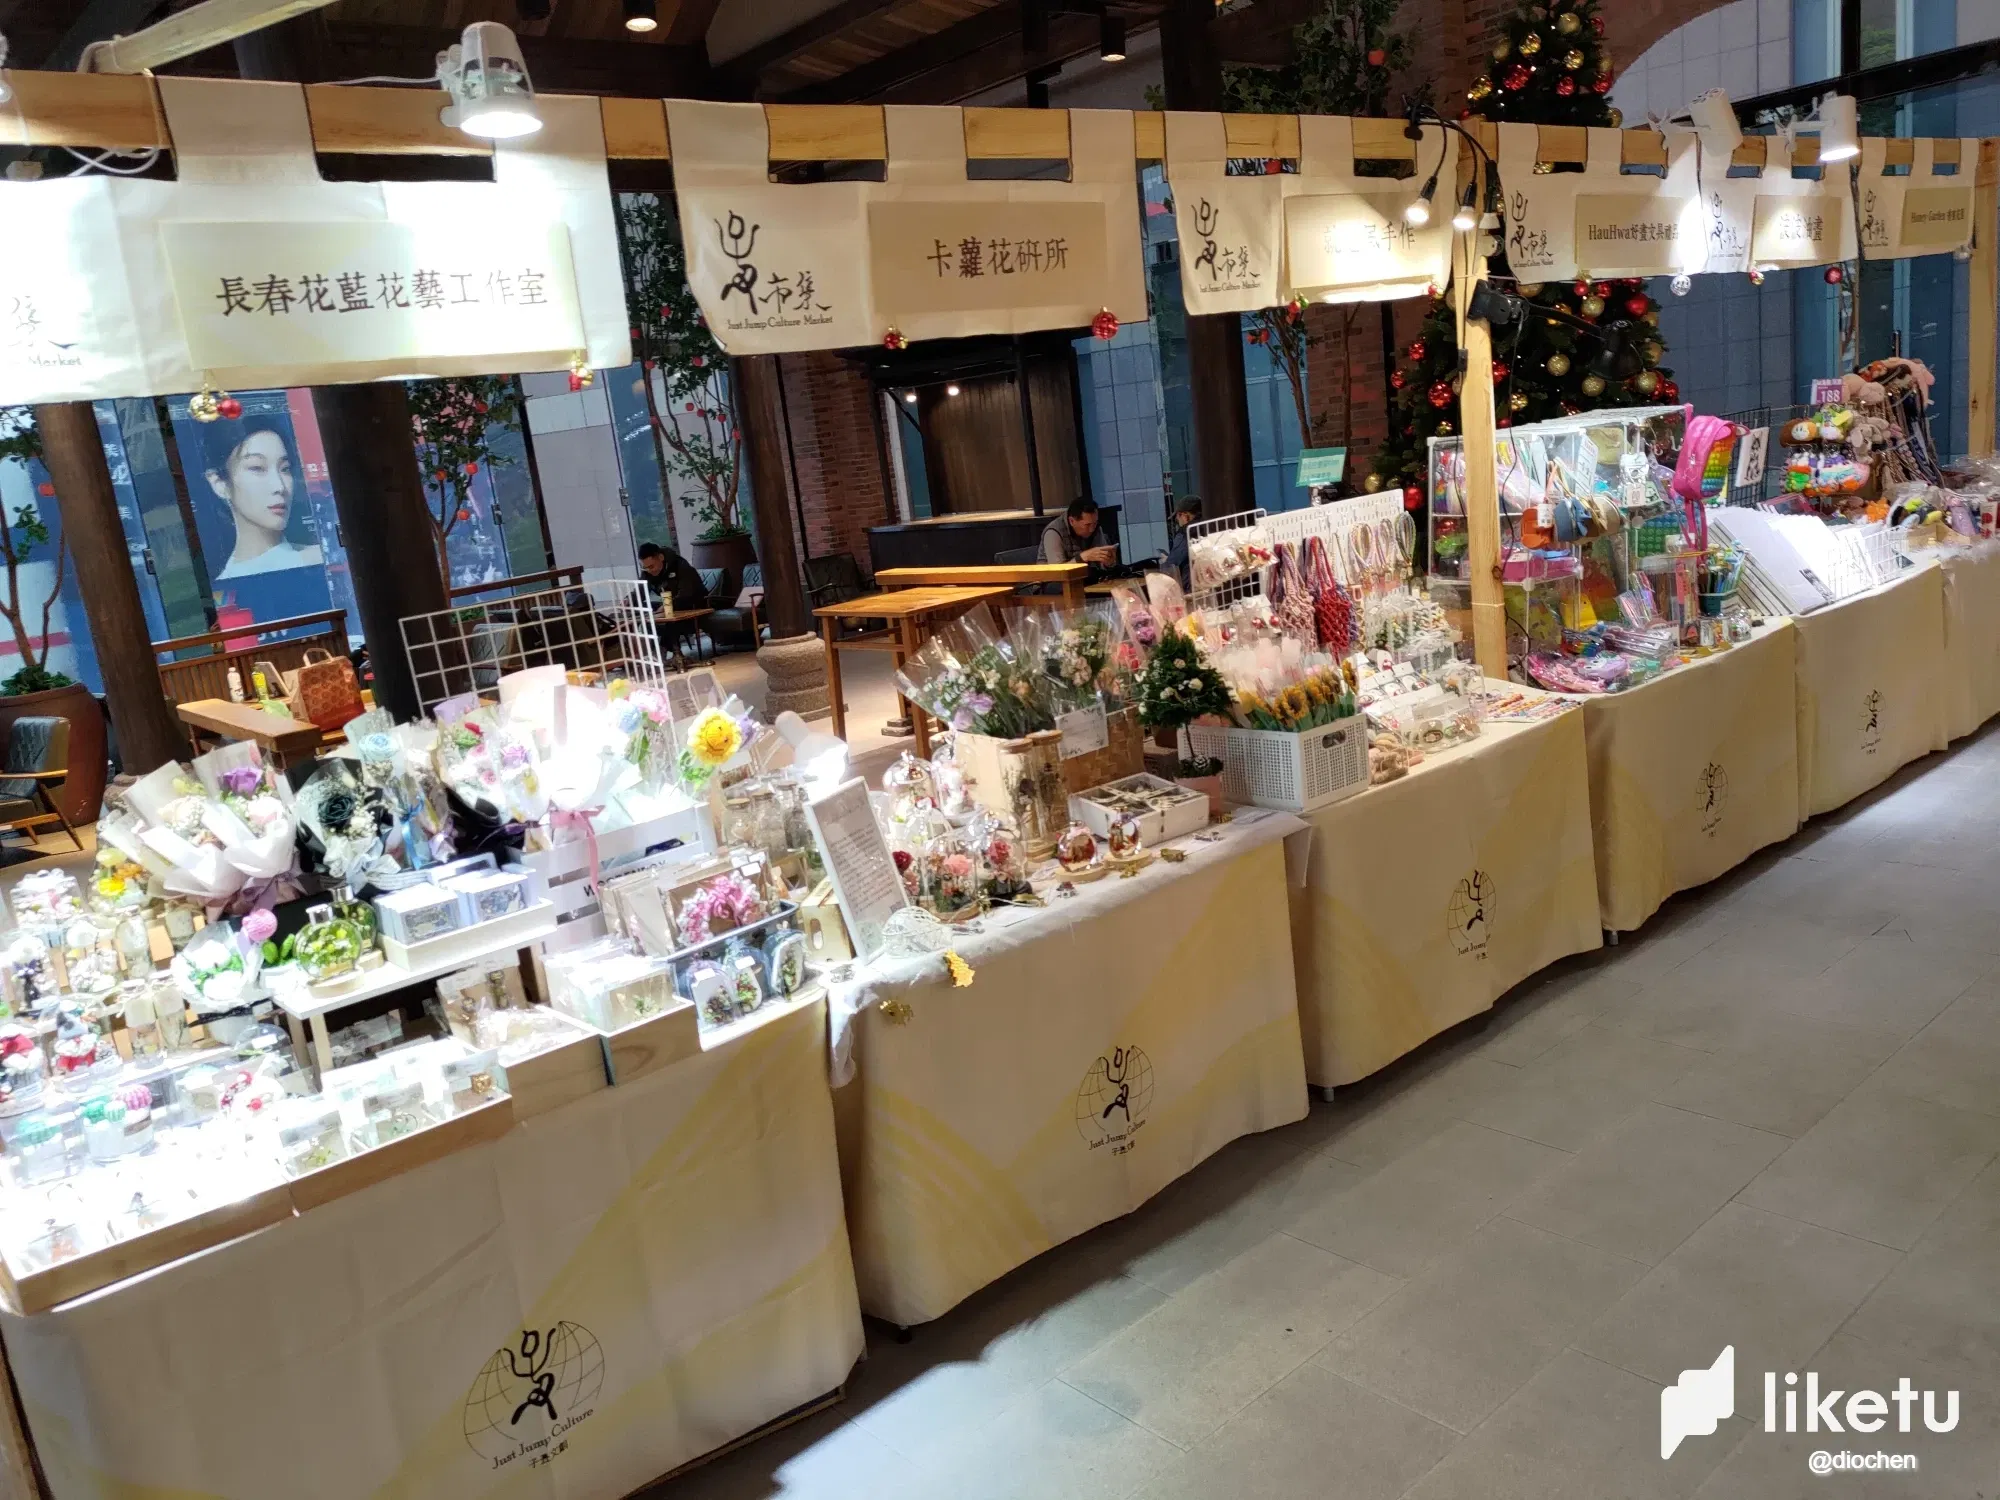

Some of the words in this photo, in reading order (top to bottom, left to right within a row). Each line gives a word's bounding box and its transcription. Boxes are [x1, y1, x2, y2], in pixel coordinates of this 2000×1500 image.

[927, 236, 1068, 278] 卡蘿花研所
[216, 268, 548, 316] 長春花藍花藝工作室
[727, 318, 743, 330] Just
[743, 317, 767, 331] Jump
[767, 316, 800, 328] Culture
[803, 314, 833, 325] Market
[1821, 389, 1840, 403] 188
[1089, 1137, 1105, 1151] Just
[1105, 1133, 1127, 1145] Jump
[1127, 1119, 1146, 1136] Culture
[492, 1450, 517, 1470] Just
[518, 1436, 552, 1456] Jump
[551, 1408, 594, 1438] Culture
